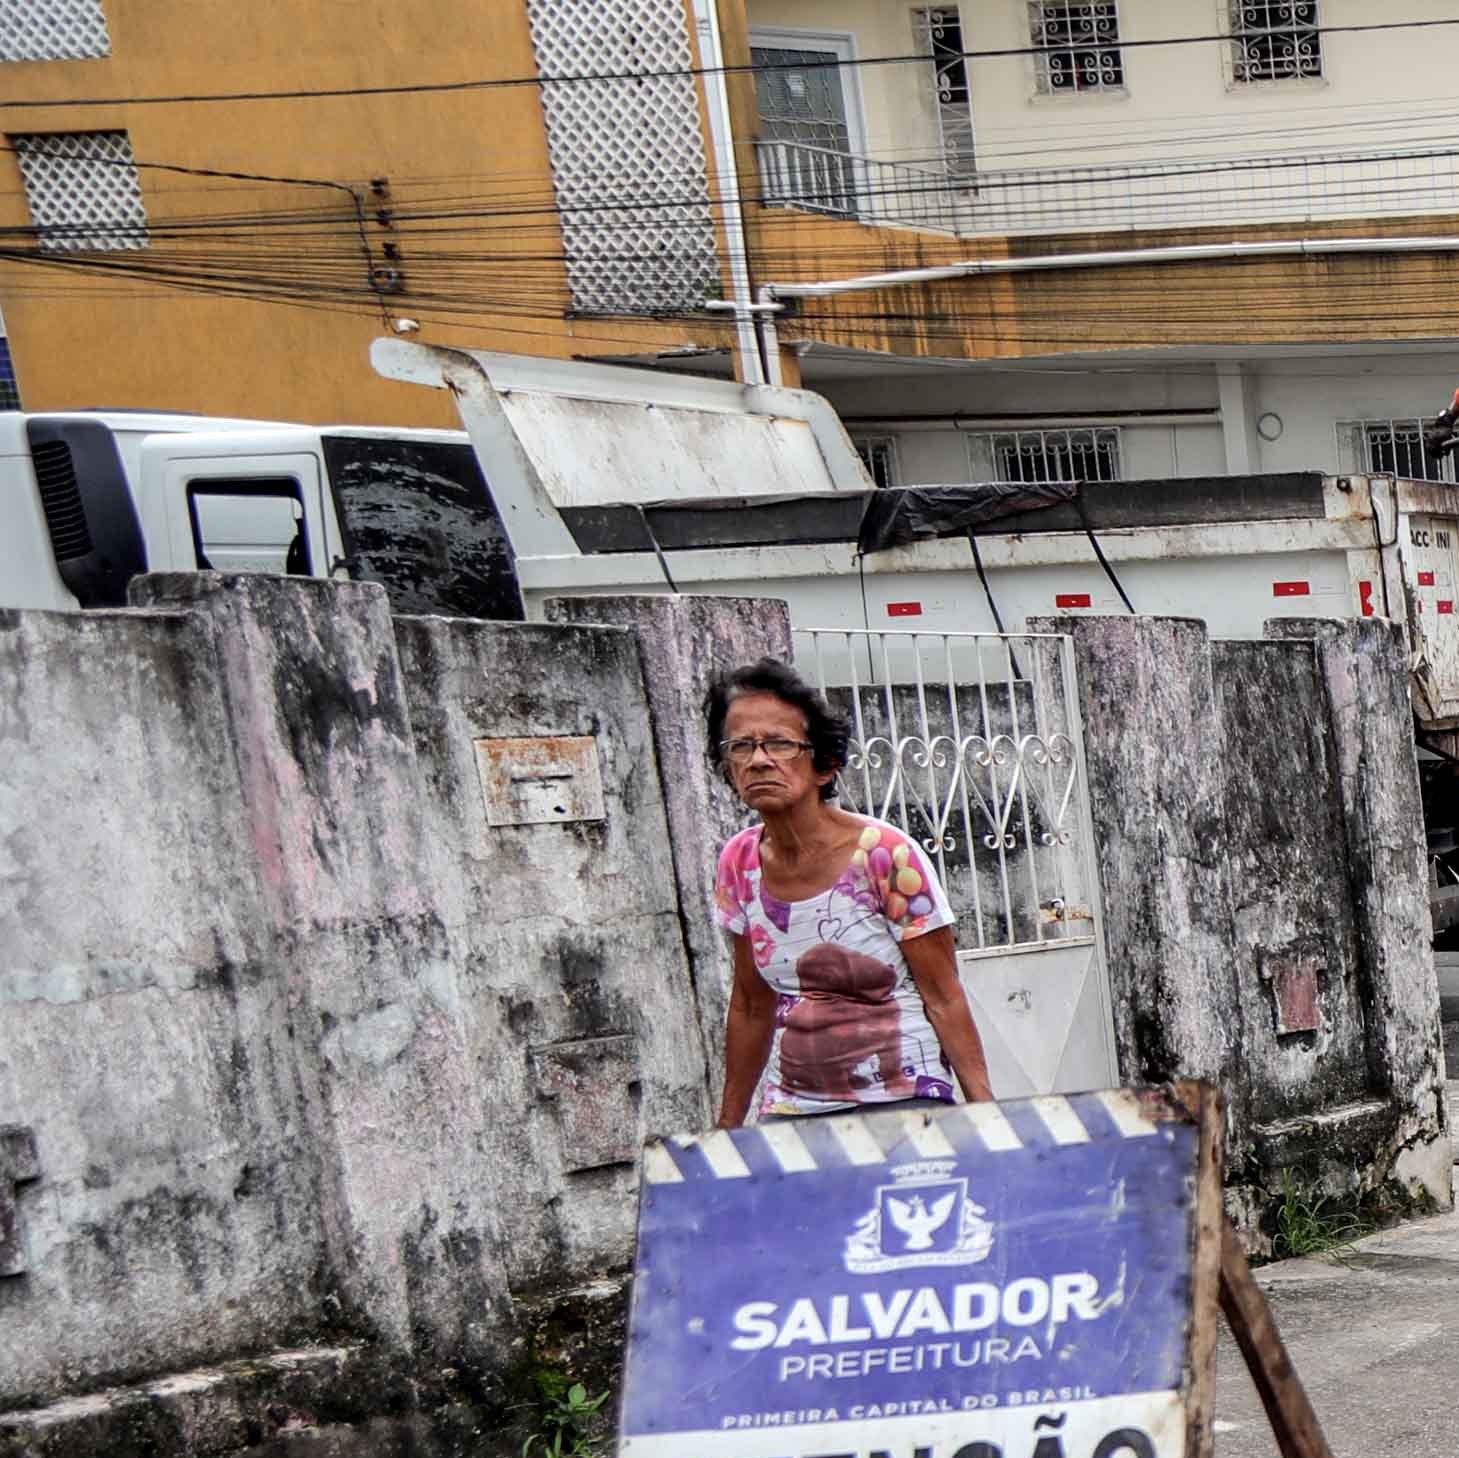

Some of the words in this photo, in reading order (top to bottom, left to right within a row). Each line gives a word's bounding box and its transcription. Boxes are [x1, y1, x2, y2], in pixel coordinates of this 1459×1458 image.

[729, 1272, 1101, 1352] SALVADOR
[779, 1336, 1042, 1382] PREFEITURA
[721, 1407, 839, 1430] PRIMEIRA
[849, 1397, 954, 1419] CAPITAL
[963, 1393, 999, 1409] DO
[1009, 1385, 1097, 1406] BRASIL
